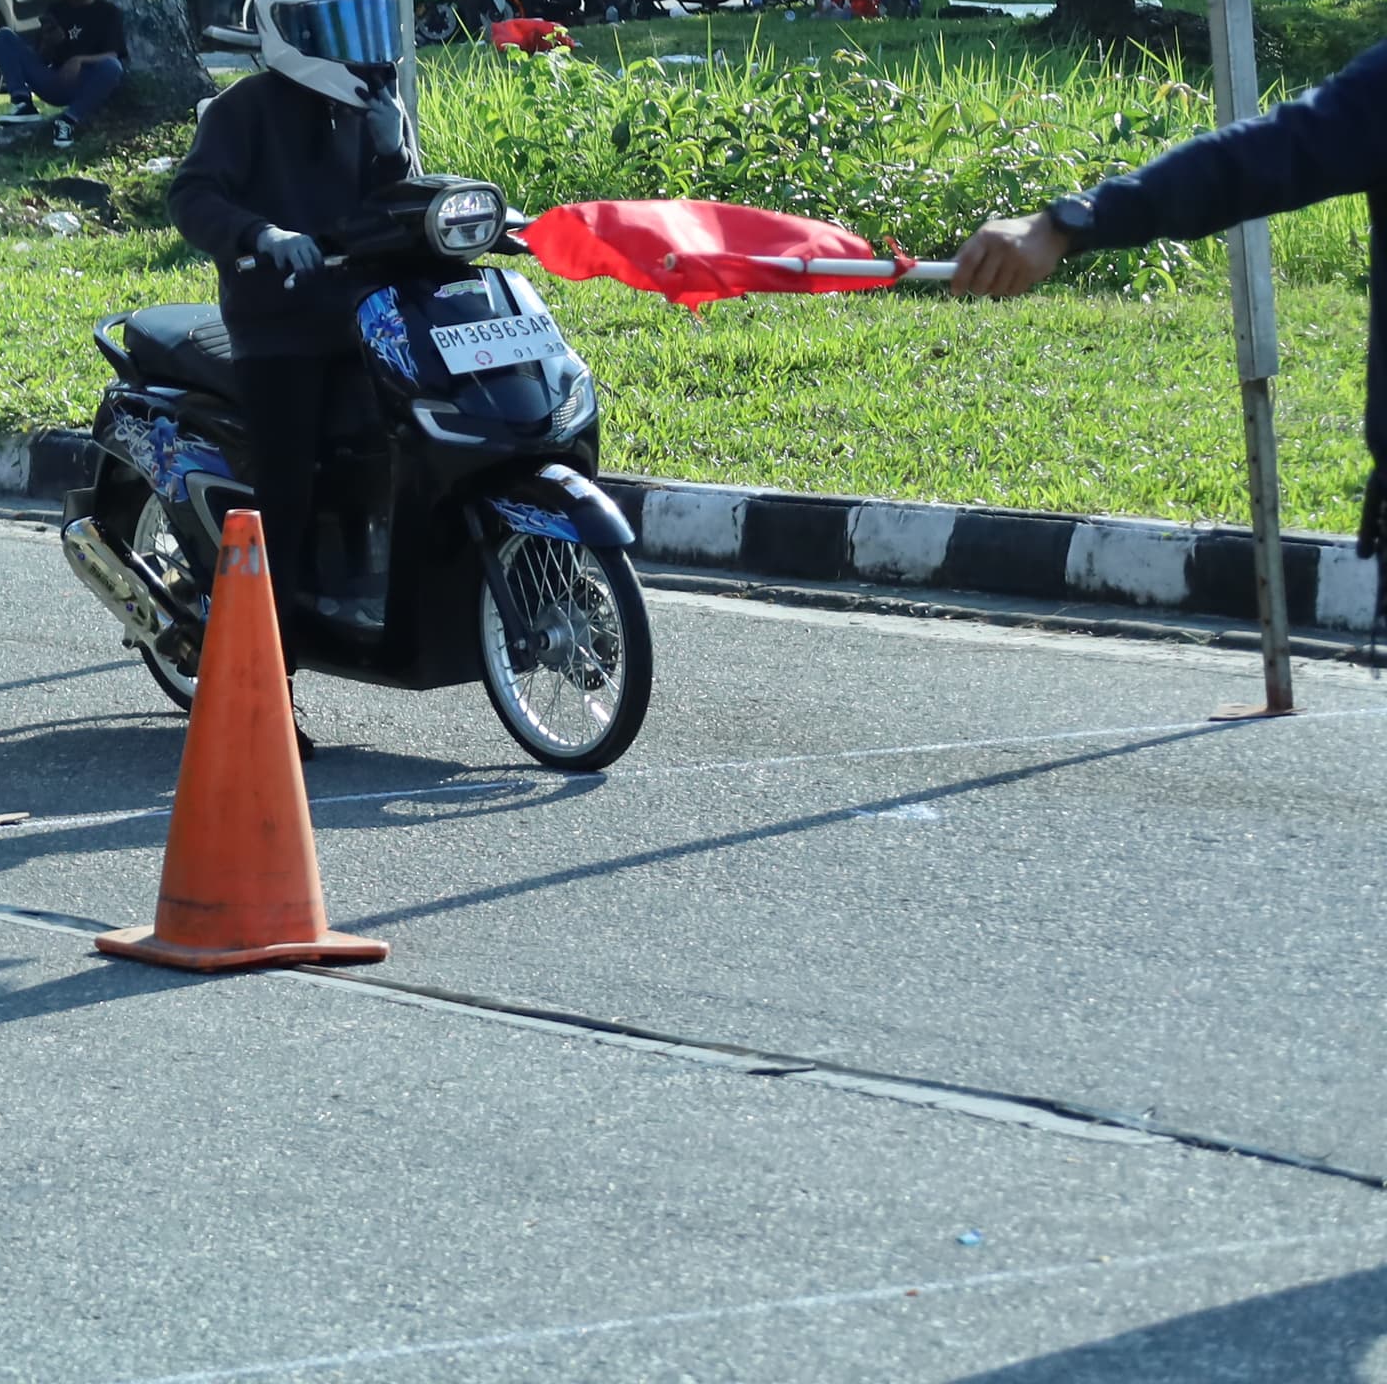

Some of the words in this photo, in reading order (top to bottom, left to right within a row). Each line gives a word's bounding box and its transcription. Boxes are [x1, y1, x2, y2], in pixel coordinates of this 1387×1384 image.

[434, 329, 466, 349] BM
[465, 321, 517, 344] 3696
[513, 346, 533, 359] 01
